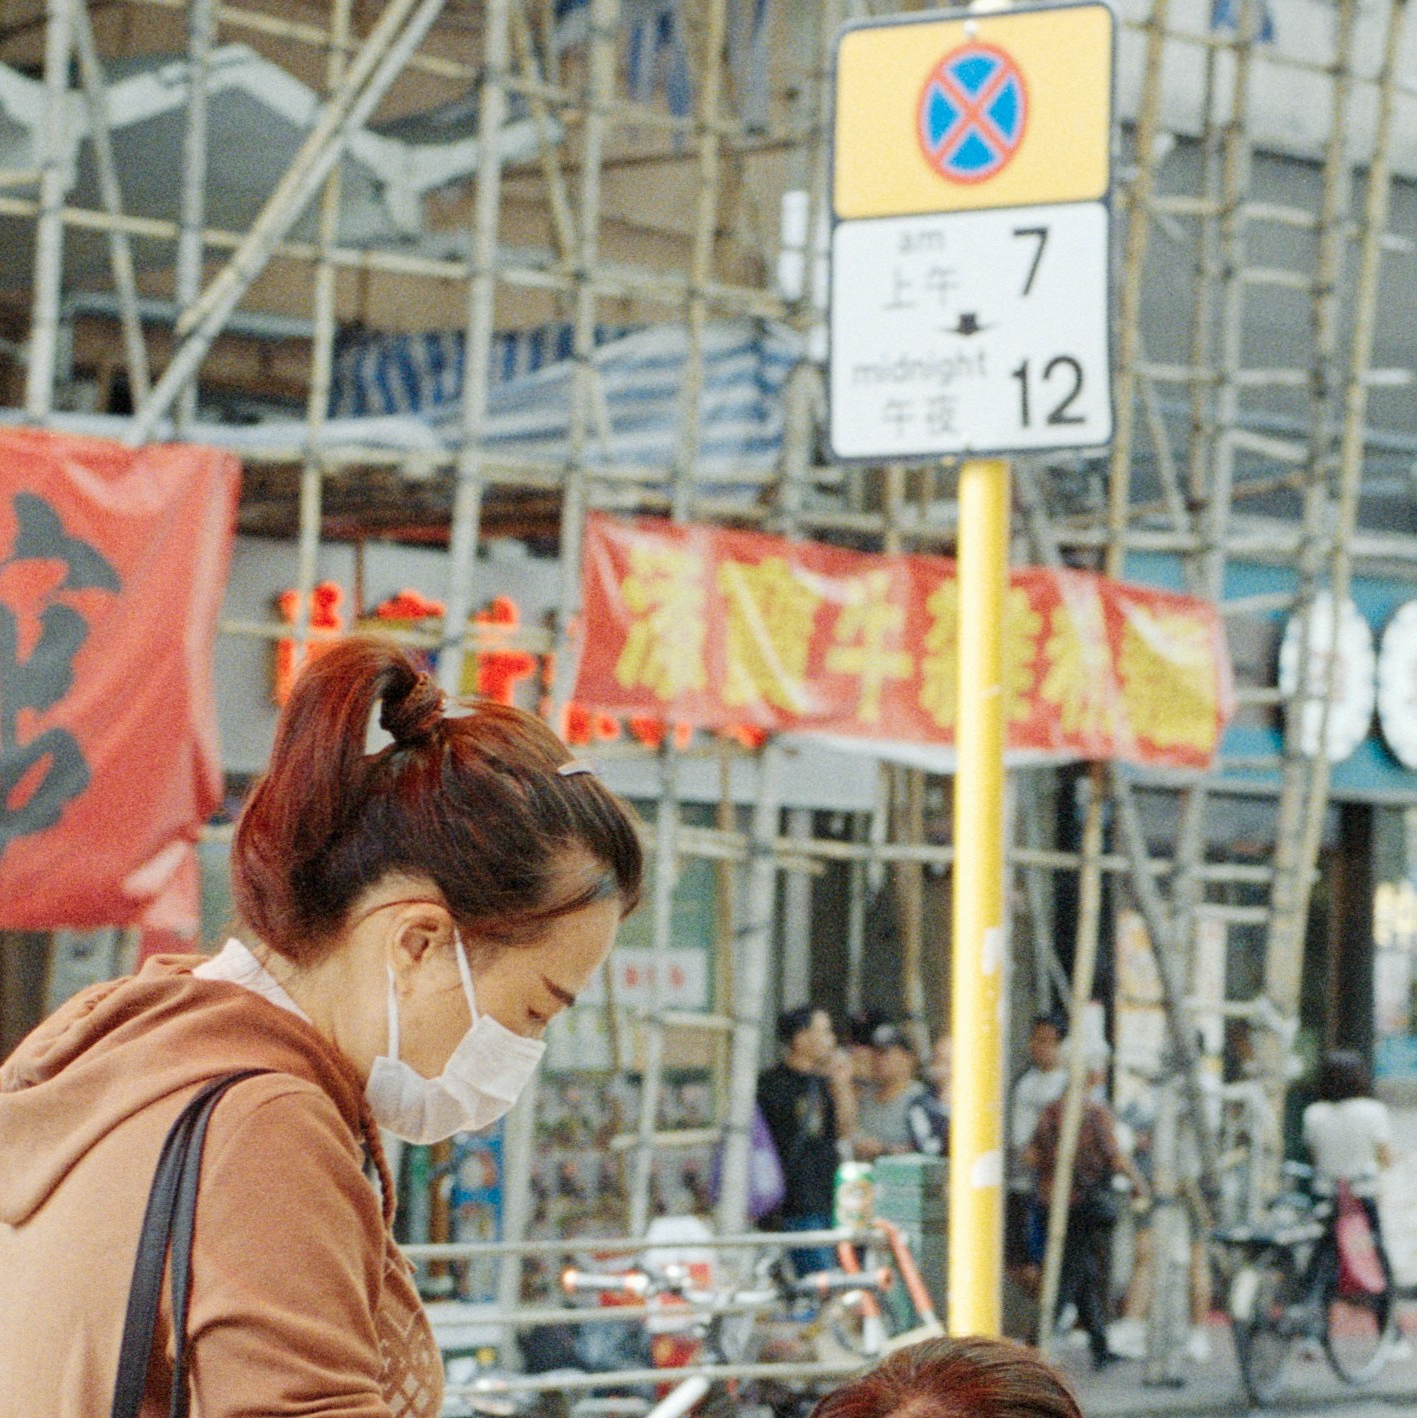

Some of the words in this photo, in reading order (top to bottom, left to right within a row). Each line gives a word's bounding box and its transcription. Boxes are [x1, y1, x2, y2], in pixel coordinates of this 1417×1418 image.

[898, 229, 945, 254] am
[1011, 225, 1050, 297] 7
[881, 265, 960, 311] 上午
[852, 350, 988, 387] midnight
[1011, 353, 1088, 430] 12
[881, 394, 961, 438] 午夜
